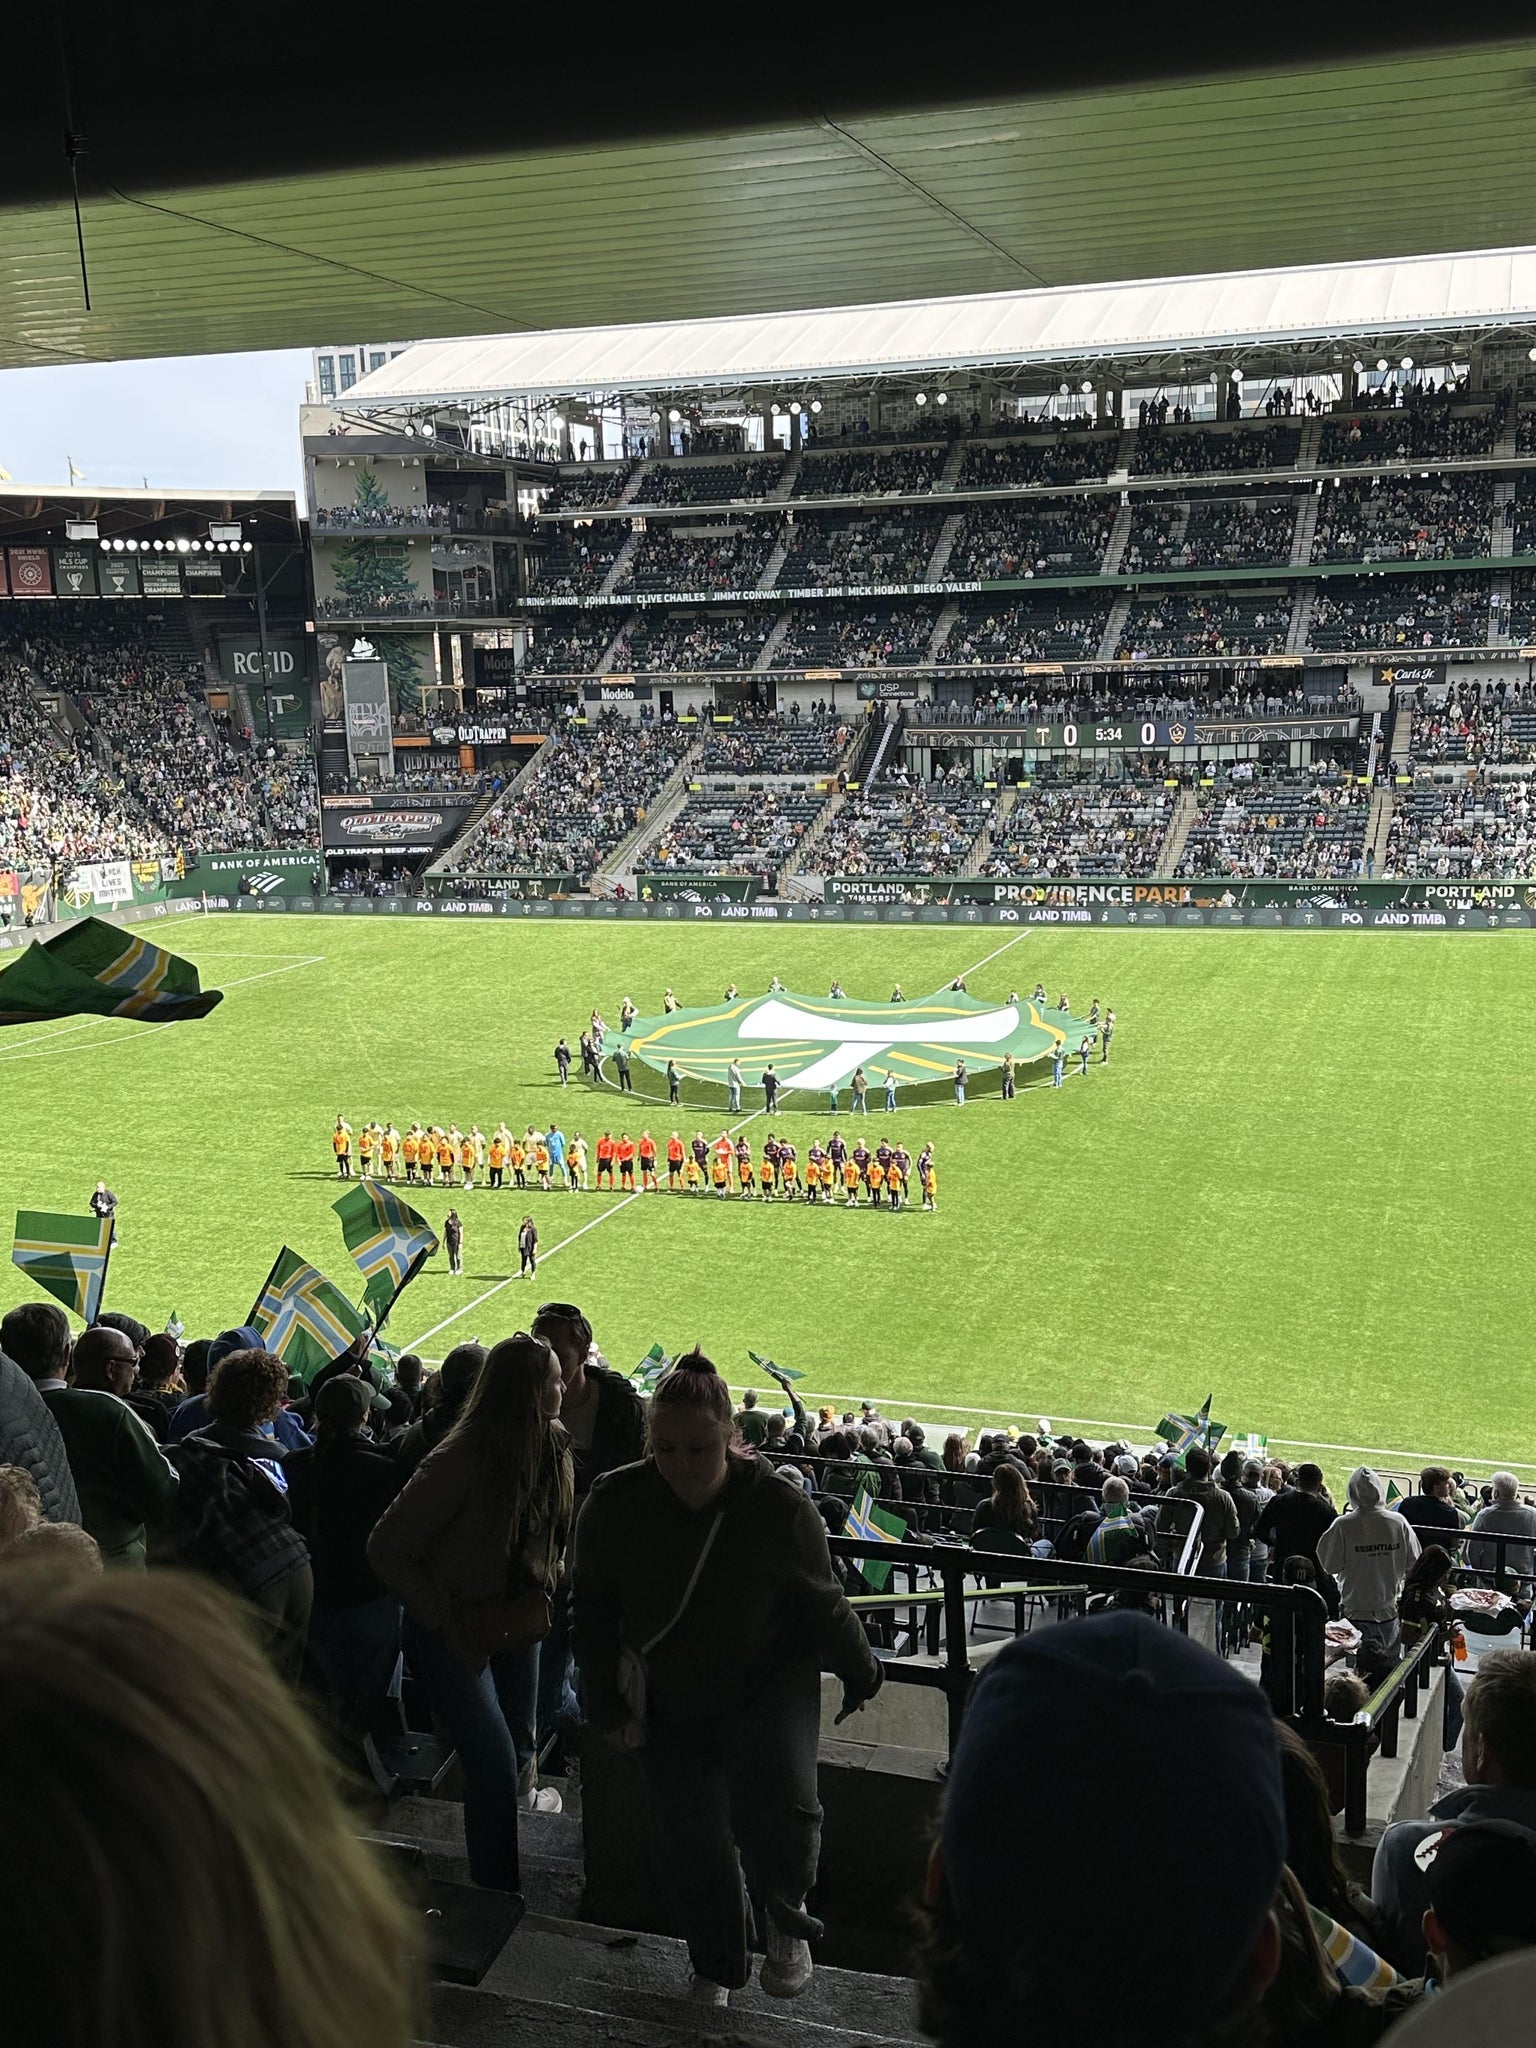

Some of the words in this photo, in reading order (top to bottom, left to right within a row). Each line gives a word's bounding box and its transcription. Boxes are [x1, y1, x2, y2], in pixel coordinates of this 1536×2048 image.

[144, 586, 181, 594] CHAMPIONS
[526, 597, 545, 606] RING
[552, 597, 578, 606] HONOR
[584, 596, 608, 605] JOHN
[610, 595, 632, 604] BAIN
[636, 594, 662, 603] CLIVE
[664, 592, 706, 603] CHARLES
[712, 591, 741, 601] JIMMY
[743, 590, 782, 600] CONWAY
[788, 588, 824, 598] TIMBER
[826, 587, 842, 597] JIM
[848, 586, 872, 596] MICK
[874, 585, 908, 595] HOBAN
[914, 584, 943, 594] DIEGO
[945, 582, 982, 592] VALERI
[233, 650, 294, 674] RCID
[484, 654, 514, 670] Mode
[601, 687, 635, 700] Modelo
[880, 683, 900, 692] DSP
[1063, 724, 1078, 746] 0
[1095, 727, 1123, 741] 5:34
[1141, 722, 1156, 745] 0
[343, 816, 372, 827] OLD
[373, 814, 442, 824] TRAPPER
[326, 848, 344, 856] OLD
[407, 846, 434, 854] JERKY
[211, 860, 244, 870] BANK
[246, 858, 260, 868] OF
[262, 856, 316, 867] AMERICA
[832, 882, 905, 894] PORTLAND
[1355, 1543, 1401, 1553] ESSENTIALS
